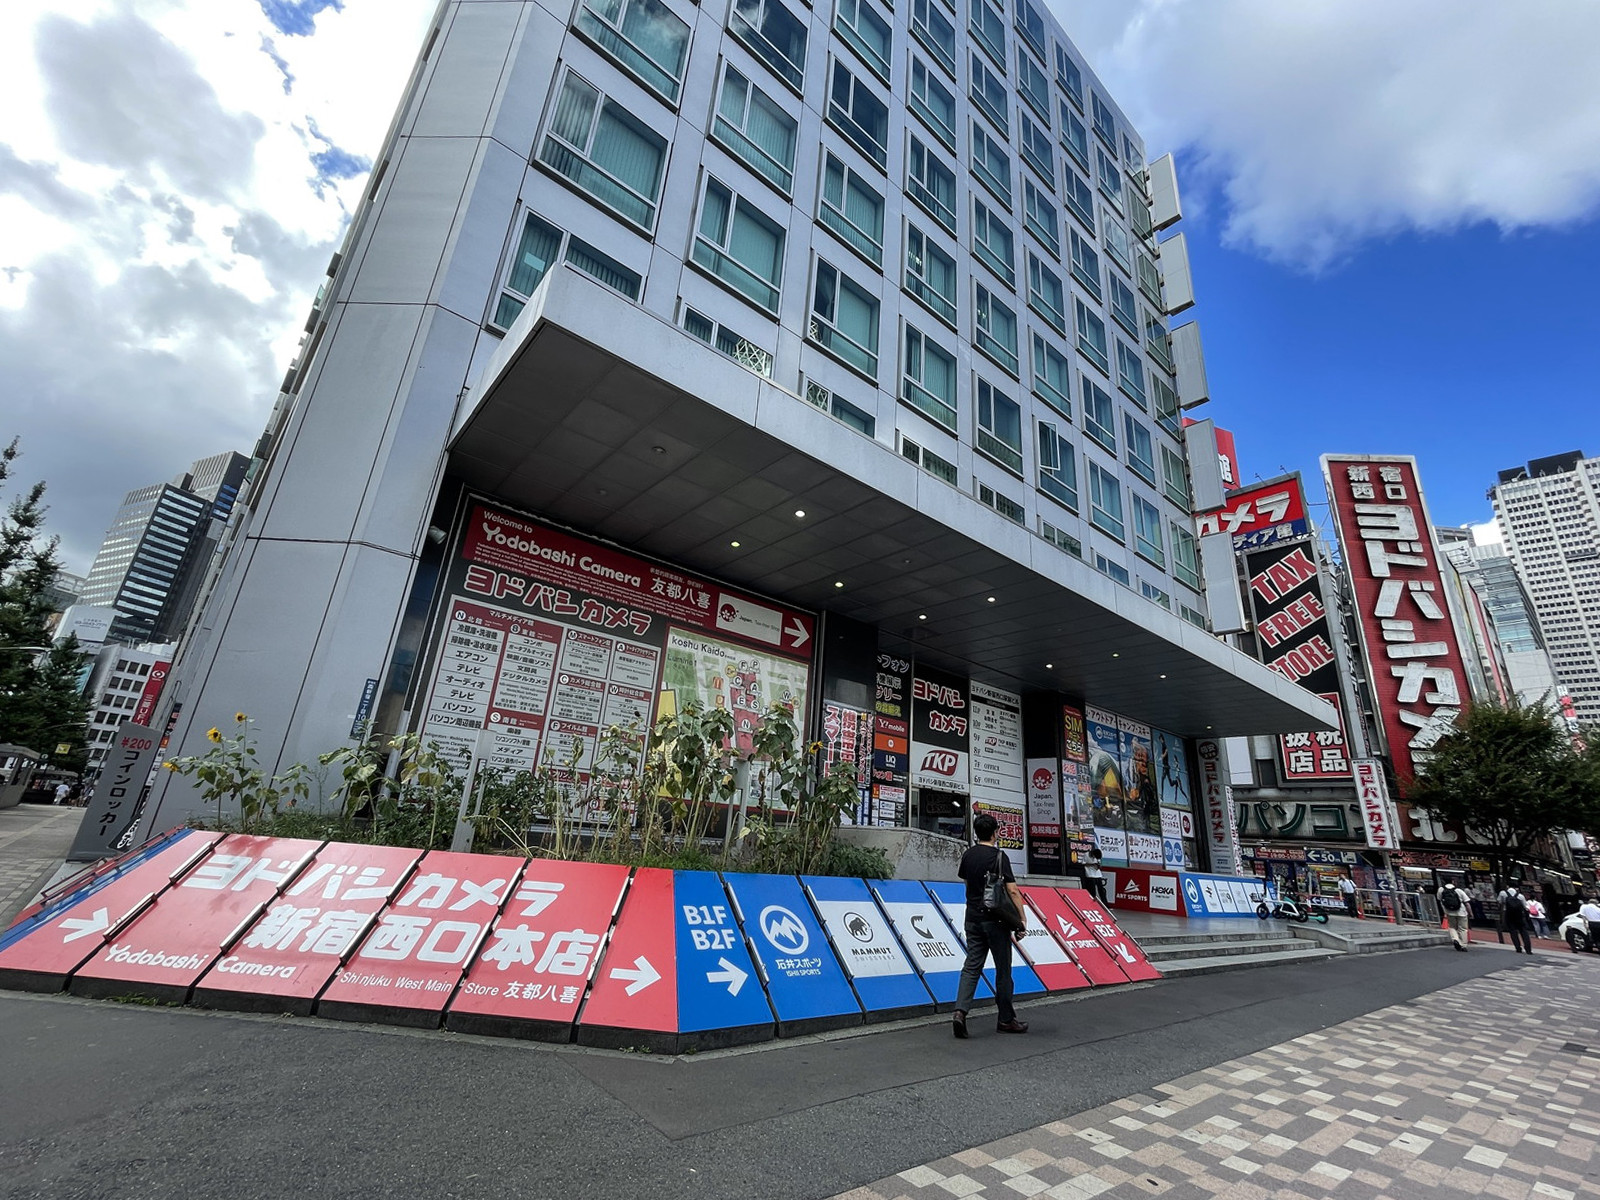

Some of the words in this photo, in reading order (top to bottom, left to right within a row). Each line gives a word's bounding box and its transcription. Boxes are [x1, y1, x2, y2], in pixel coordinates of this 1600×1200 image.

[1347, 465, 1403, 482] 新宿
[1350, 482, 1407, 500] 西口
[483, 510, 523, 531] Welcome
[523, 525, 533, 534] to
[482, 522, 576, 567] Yodobashi
[579, 556, 641, 588] Camera
[1250, 547, 1318, 604] TAX
[464, 564, 651, 636] ヨドバシカメラ
[650, 577, 711, 610] 友都八喜
[1257, 591, 1326, 649] FREE
[455, 650, 489, 663] エアコン
[456, 664, 482, 675] テレビ
[445, 675, 486, 689] オーディオ
[913, 677, 966, 709] ヨドバシ
[442, 701, 477, 714] パソコン
[929, 710, 967, 737] カメラ
[1064, 714, 1084, 733] SIM
[121, 736, 152, 751] ¥200
[925, 752, 956, 772] TKP
[99, 750, 140, 836] コインロッカー
[1034, 792, 1053, 802] Japan.
[1204, 761, 1225, 844] ヨドバシカメラ
[1033, 801, 1055, 809] Tax-free
[1036, 808, 1051, 817] Shop
[1357, 765, 1386, 847] ヨドバシカメラ
[181, 854, 566, 918] ヨドバシカメラ
[1151, 885, 1175, 895] HOKA
[1128, 894, 1148, 902] SPORTS
[681, 904, 728, 926] B1F
[1083, 909, 1105, 923] B1F
[243, 904, 600, 976] 新宿西口本店
[690, 927, 737, 951] B2F
[1095, 923, 1117, 938] B2F
[851, 947, 892, 956] MAMMUT
[916, 941, 956, 958] GRIVEL
[104, 943, 210, 971] Yodobashi
[215, 955, 298, 979] Camera
[775, 957, 822, 970] 石井スポーツ
[785, 968, 801, 977] ISHII
[800, 968, 822, 977] SPORTS
[339, 970, 393, 988] Shinjuku
[395, 975, 424, 991] West
[425, 978, 452, 993] Main
[464, 982, 500, 997] Store
[502, 980, 579, 1005] 友都八喜
